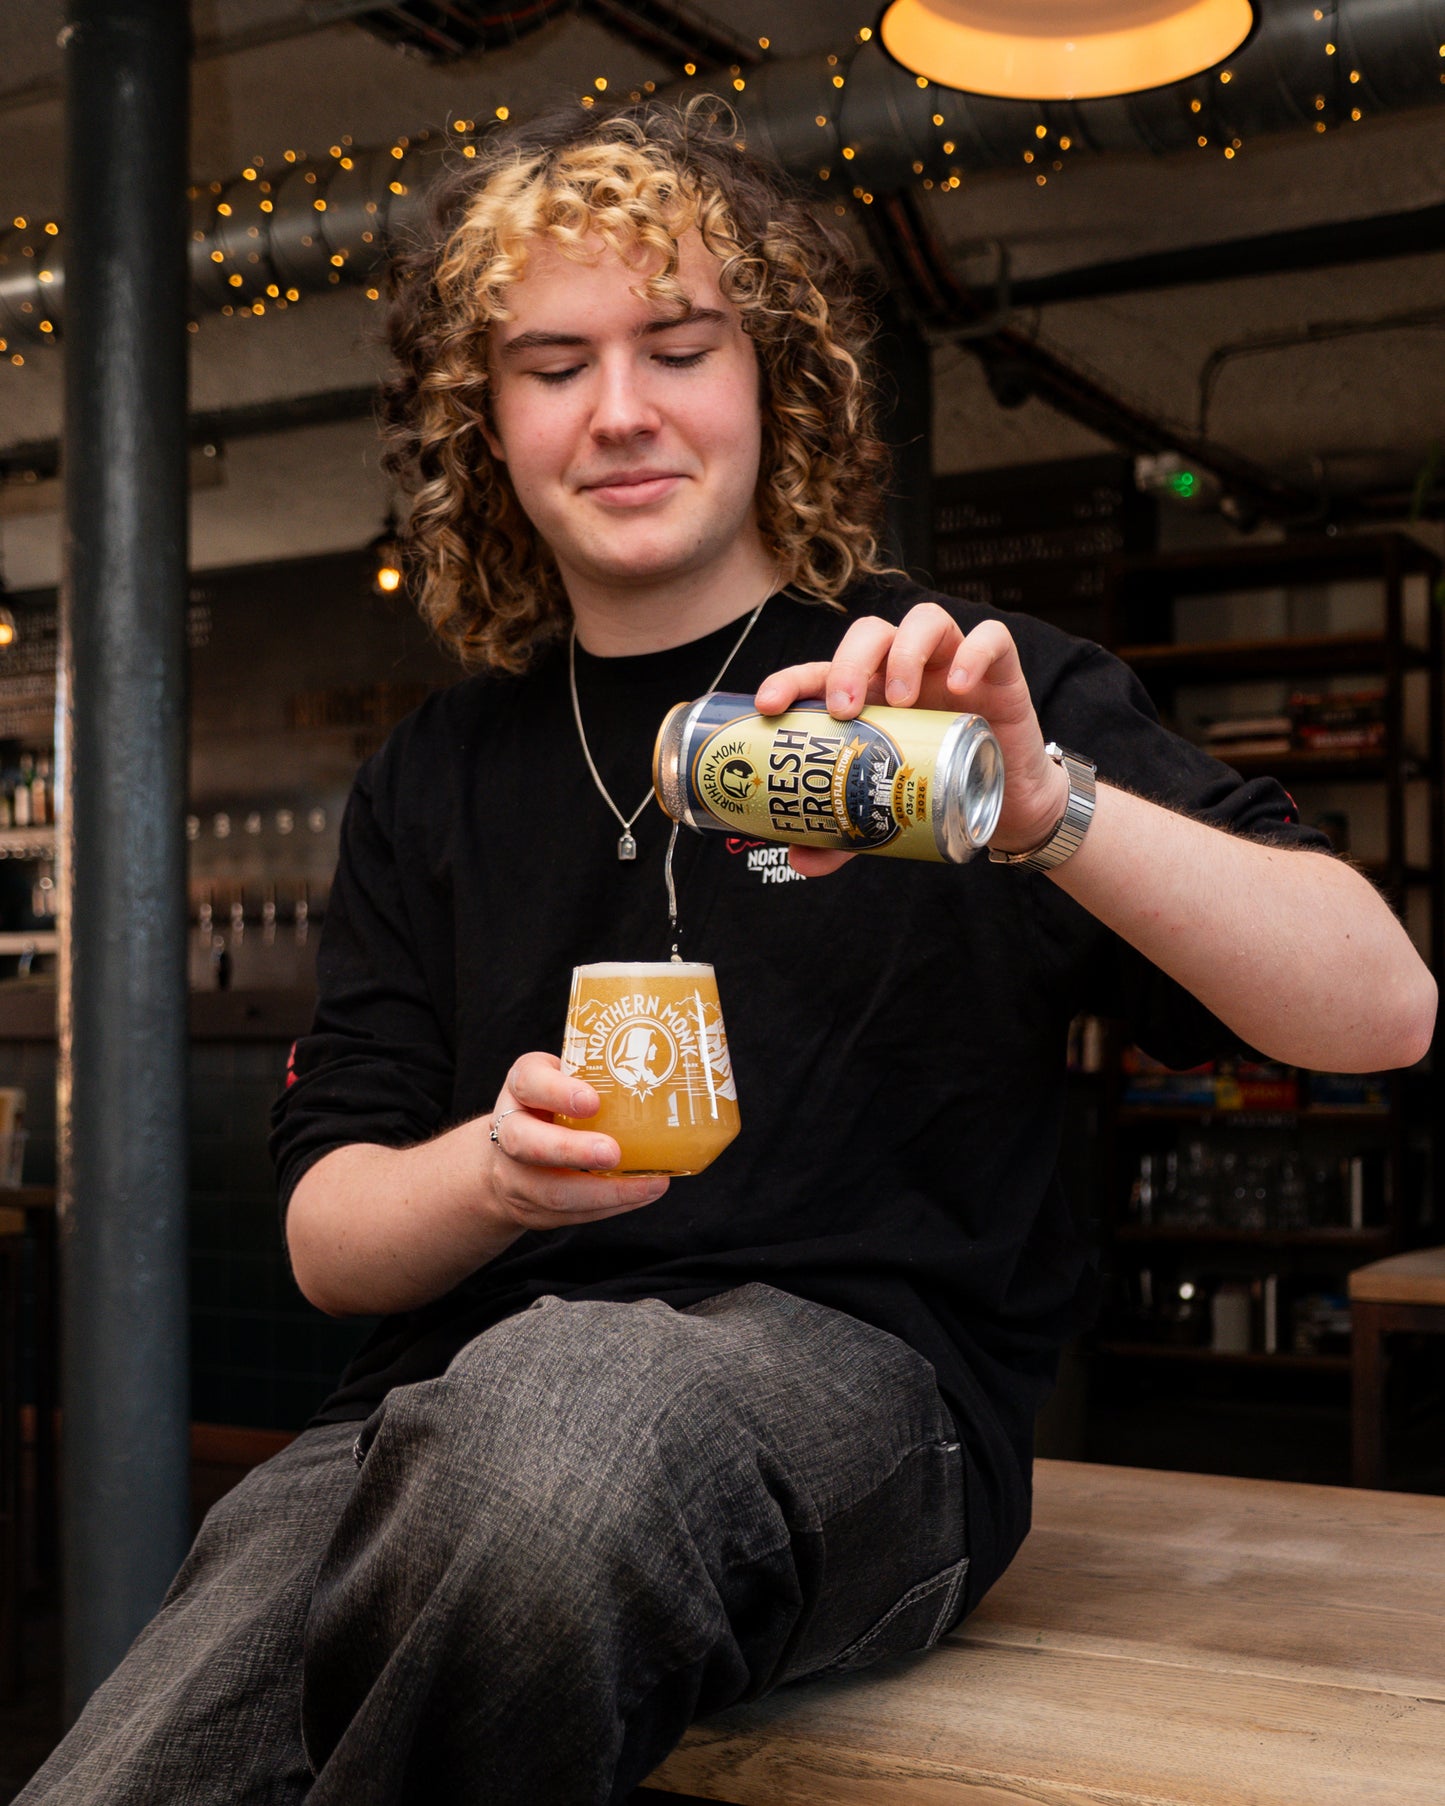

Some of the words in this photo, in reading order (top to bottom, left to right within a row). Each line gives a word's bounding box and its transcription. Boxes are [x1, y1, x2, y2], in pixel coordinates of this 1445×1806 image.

[711, 741, 746, 764] MONK
[837, 748, 854, 774] STORE
[767, 728, 809, 834] FRESH
[801, 736, 842, 835] FROM
[833, 775, 844, 798] FLAX
[851, 763, 860, 787] ALE
[907, 781, 915, 791] 12
[704, 764, 744, 815] NORTHERN
[895, 775, 906, 819] EDITION
[834, 799, 845, 815] OLD
[906, 803, 914, 816] 03
[839, 816, 851, 832] THE
[747, 847, 789, 867] NORT
[586, 993, 660, 1061] NORTHERN
[659, 1002, 699, 1058] MONK
